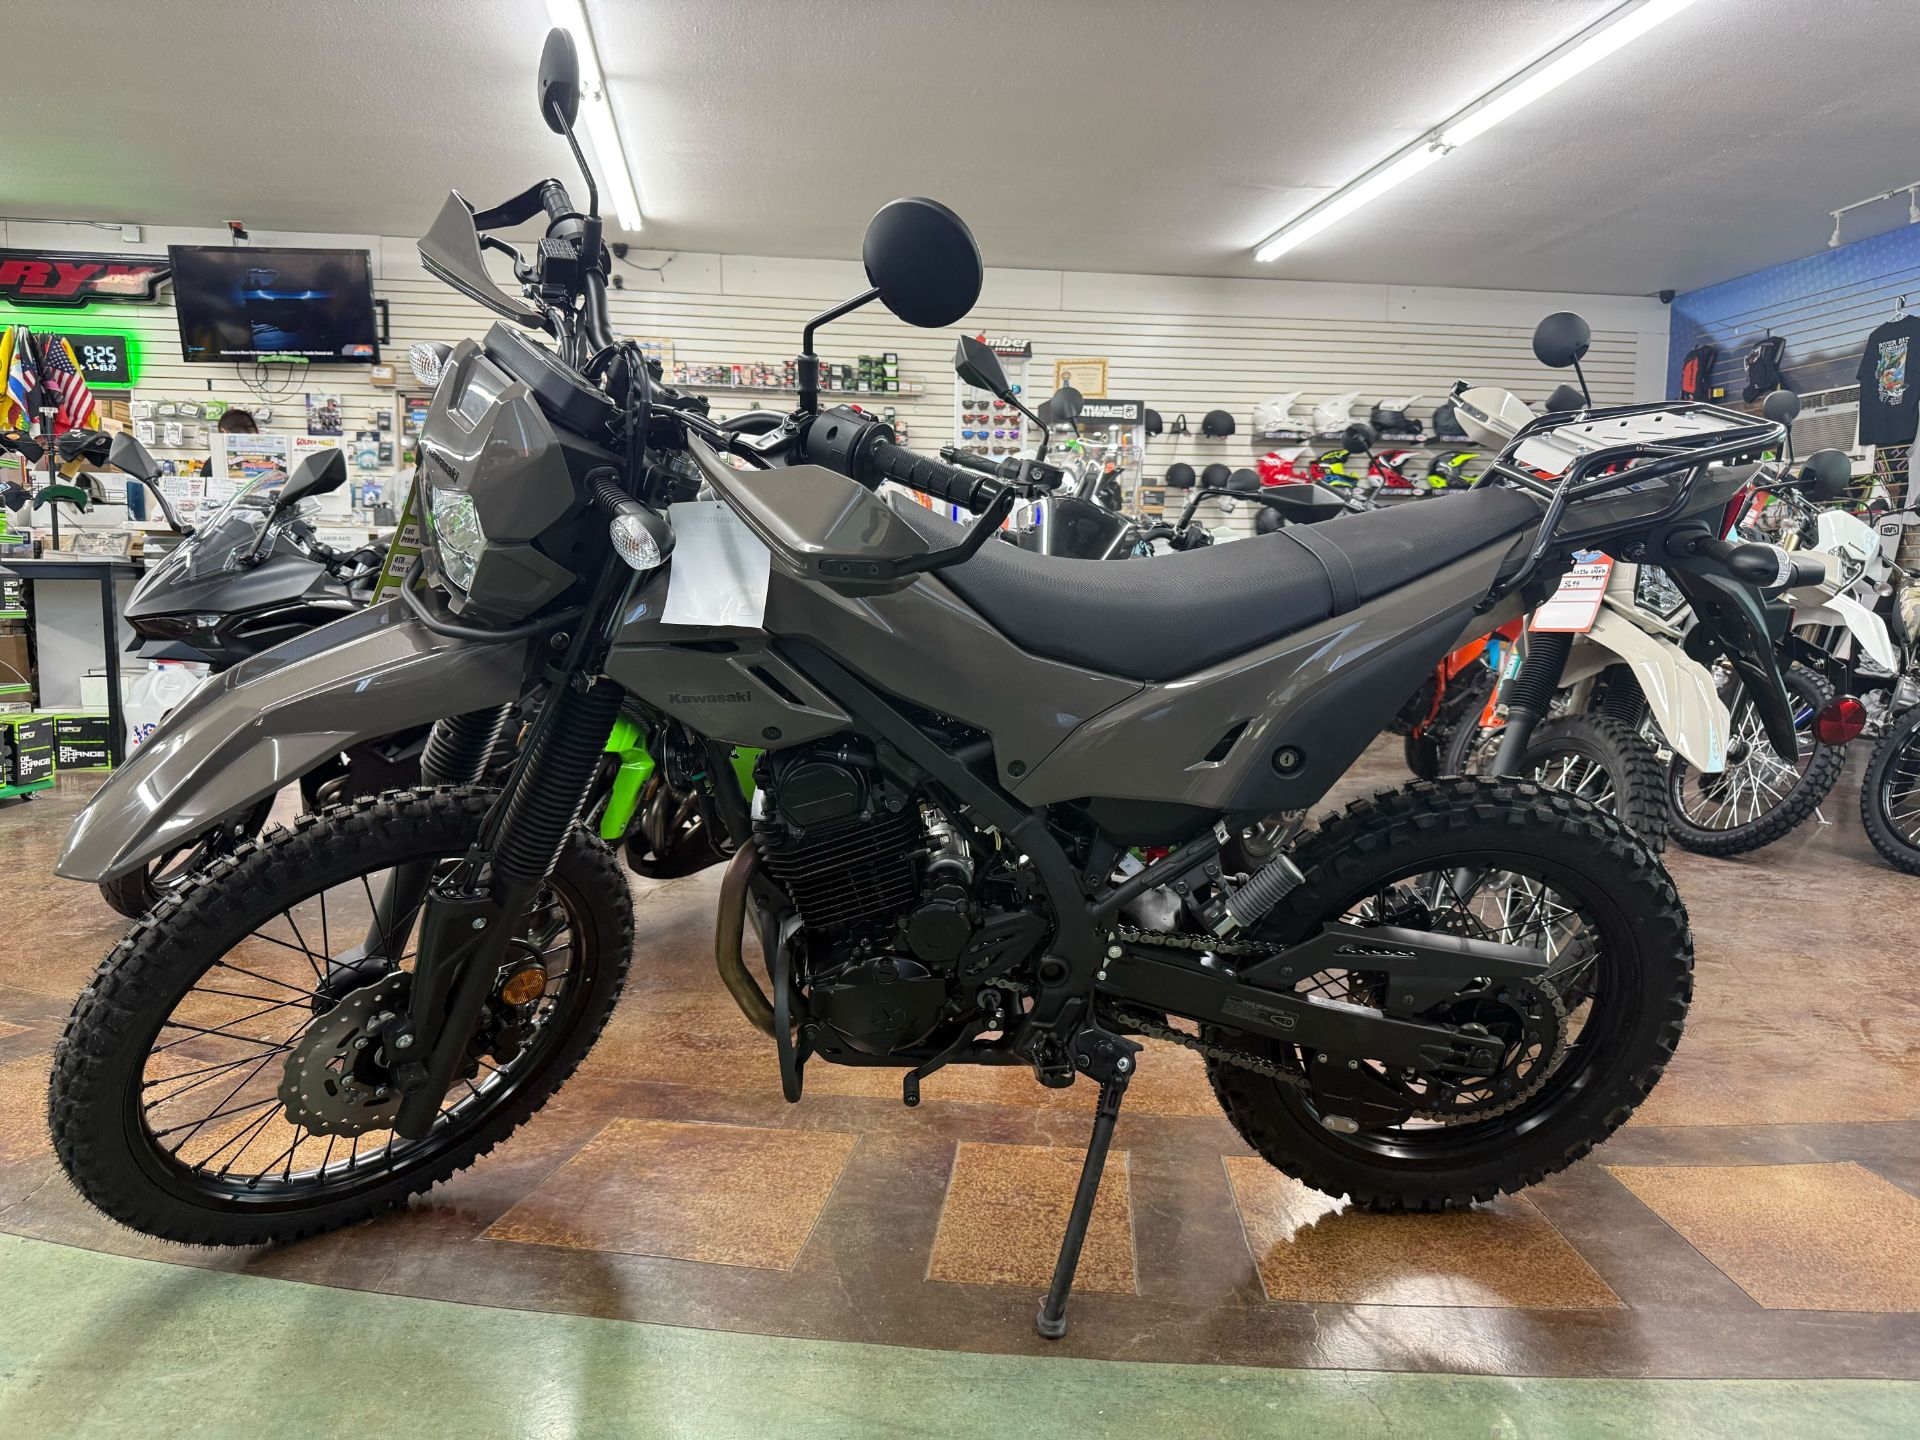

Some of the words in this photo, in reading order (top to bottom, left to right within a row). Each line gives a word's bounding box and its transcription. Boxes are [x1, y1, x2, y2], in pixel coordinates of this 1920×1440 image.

[83, 345, 117, 364] 9:25
[668, 691, 751, 705] Kawasaki
[20, 755, 33, 763] OIL
[20, 757, 51, 770] CHANGE
[20, 767, 33, 776] KIT
